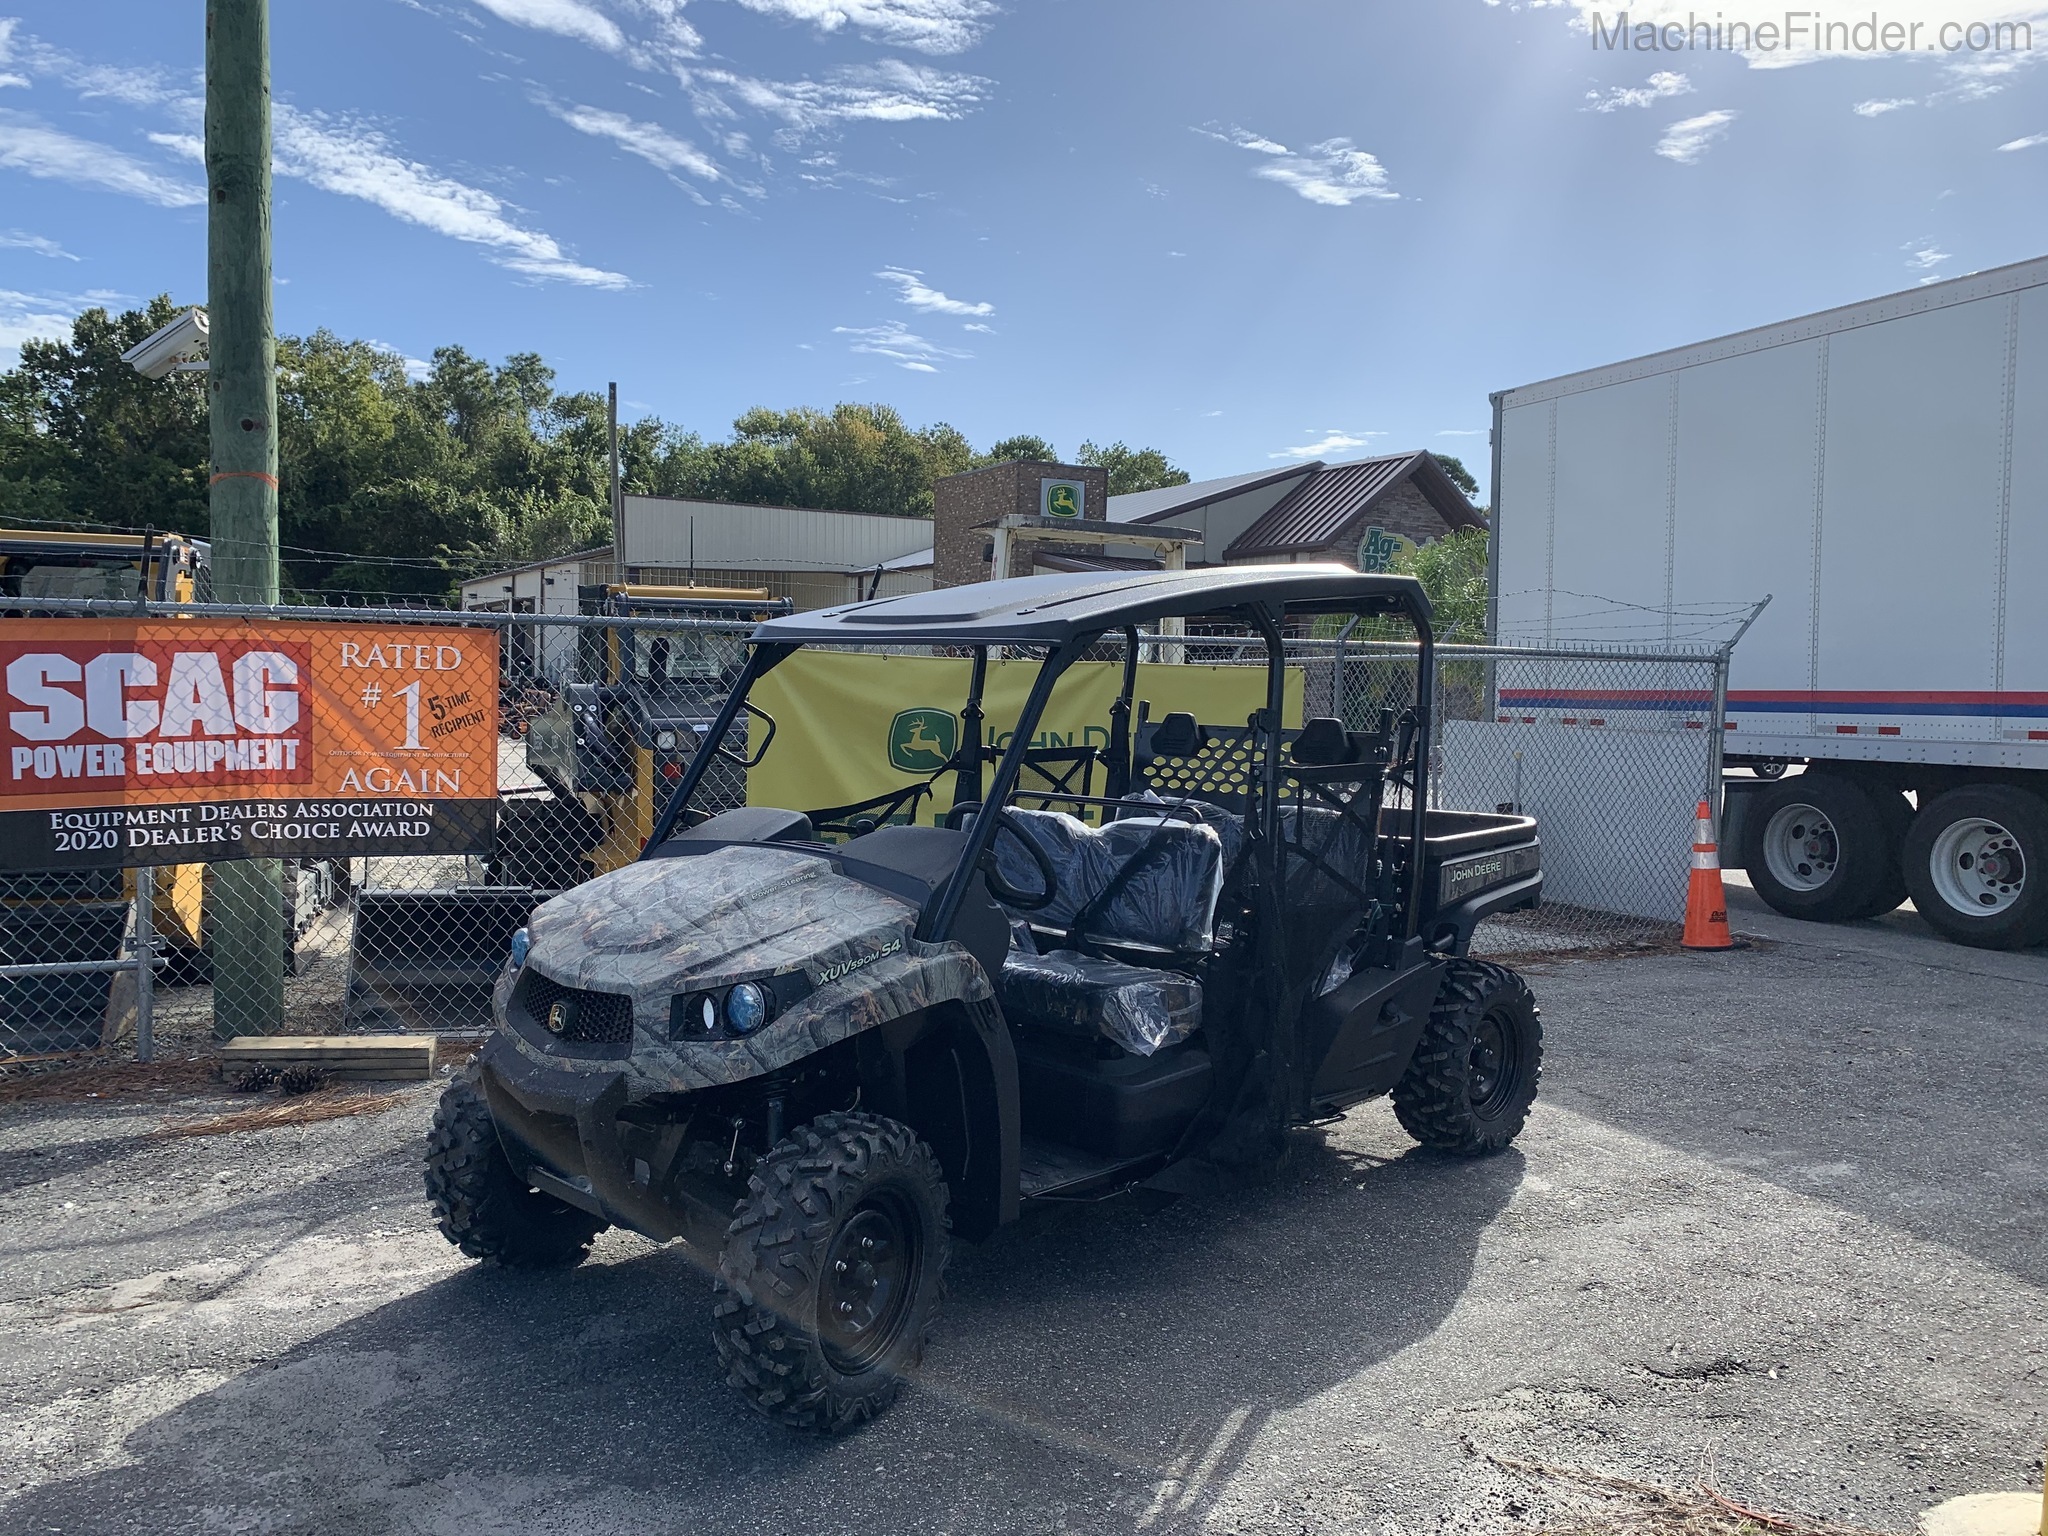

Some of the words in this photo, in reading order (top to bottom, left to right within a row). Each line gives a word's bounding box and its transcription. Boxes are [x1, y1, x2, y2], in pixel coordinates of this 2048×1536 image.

[1362, 527, 1403, 561] Ag-
[339, 641, 463, 671] RATED
[6, 651, 299, 741] SCAG
[427, 690, 473, 721] 5-TIME
[431, 709, 486, 738] RECIPIENT
[11, 744, 125, 780] POWER
[135, 739, 300, 775] EQUIPMENT
[338, 767, 462, 793] AGAIN
[50, 808, 192, 831] EQUIPMENT
[200, 803, 288, 822] DEALERS
[293, 802, 434, 819] ASSOCIATION
[55, 829, 119, 851] 2020
[127, 822, 242, 848] DEALER'S
[250, 821, 340, 839] CHOICE
[346, 820, 431, 838] AWARD
[751, 885, 779, 900] Power
[780, 871, 817, 888] Steering
[1451, 867, 1474, 882] JOHN
[1474, 861, 1501, 876] DEERE
[881, 938, 902, 957] S4
